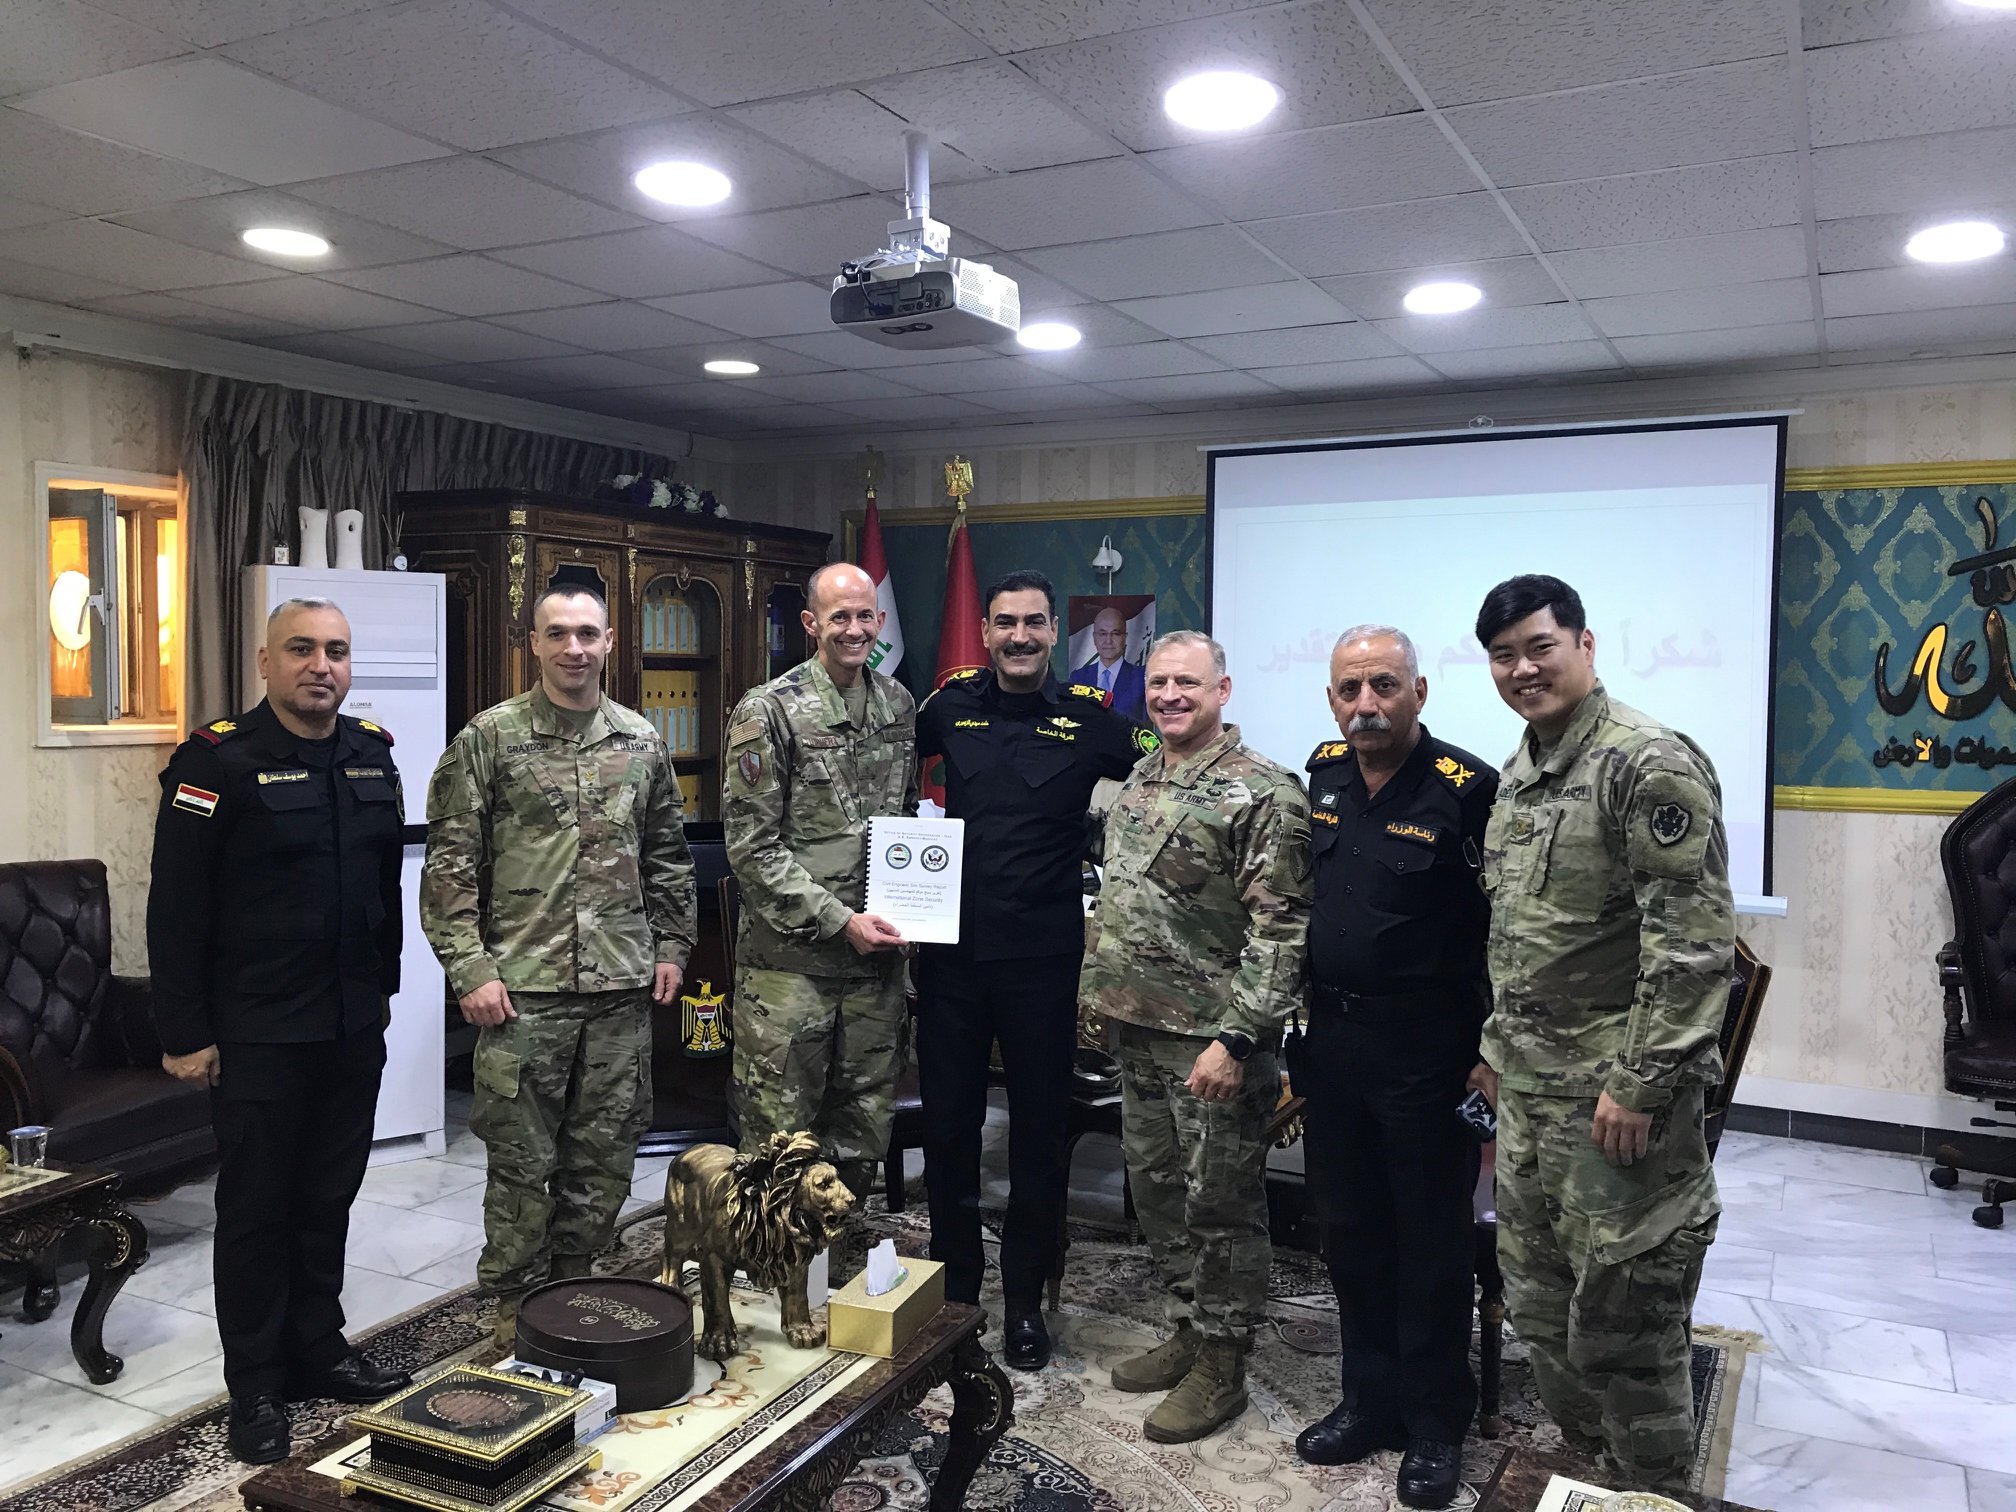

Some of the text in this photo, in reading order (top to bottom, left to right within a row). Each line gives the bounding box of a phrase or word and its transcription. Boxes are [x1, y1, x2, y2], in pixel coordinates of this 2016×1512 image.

[506, 742, 549, 754] GRAYDON
[631, 743, 649, 752] ARMY
[1185, 794, 1206, 806] ARMY
